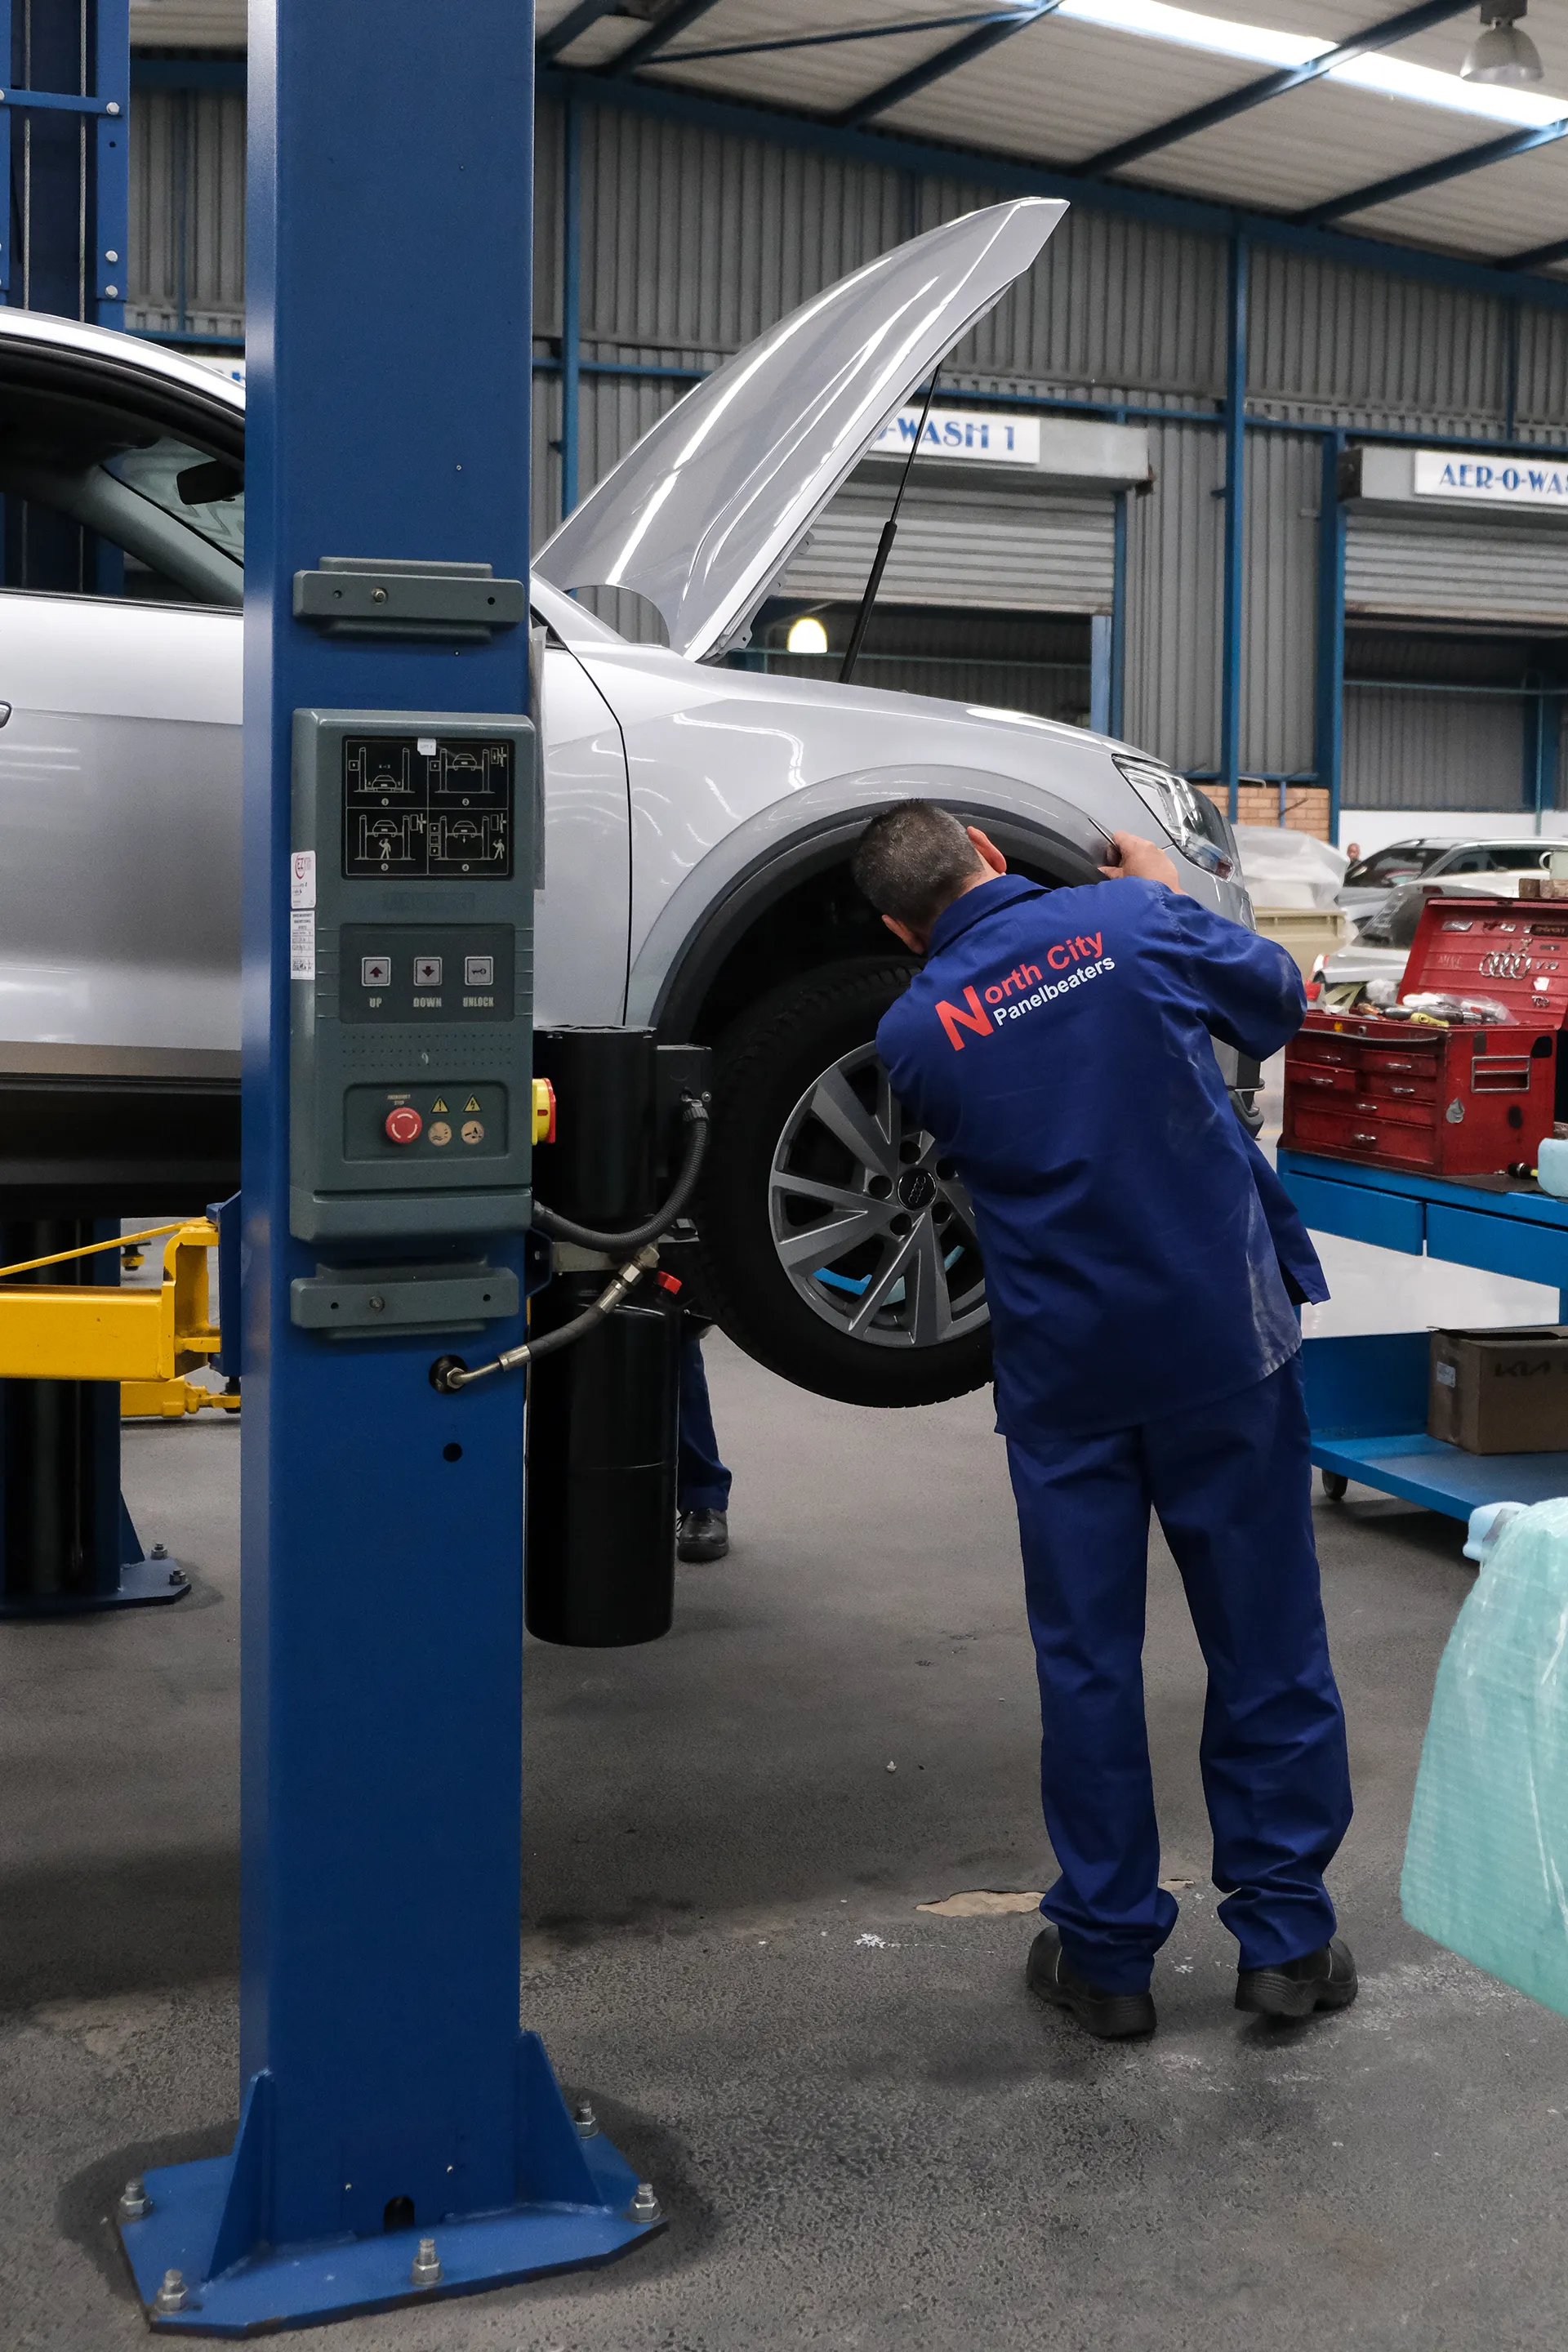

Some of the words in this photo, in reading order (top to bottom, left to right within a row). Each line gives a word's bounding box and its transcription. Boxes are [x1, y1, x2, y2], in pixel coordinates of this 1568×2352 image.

[1004, 425, 1014, 450] 1
[1440, 463, 1568, 495] AER-O-WA
[369, 997, 382, 1008] UP
[413, 997, 442, 1008] DOWN
[462, 996, 494, 1008] UNLOCK
[934, 964, 1043, 1051] North
[1047, 932, 1102, 969] City
[993, 957, 1115, 1026] Panelbeaters
